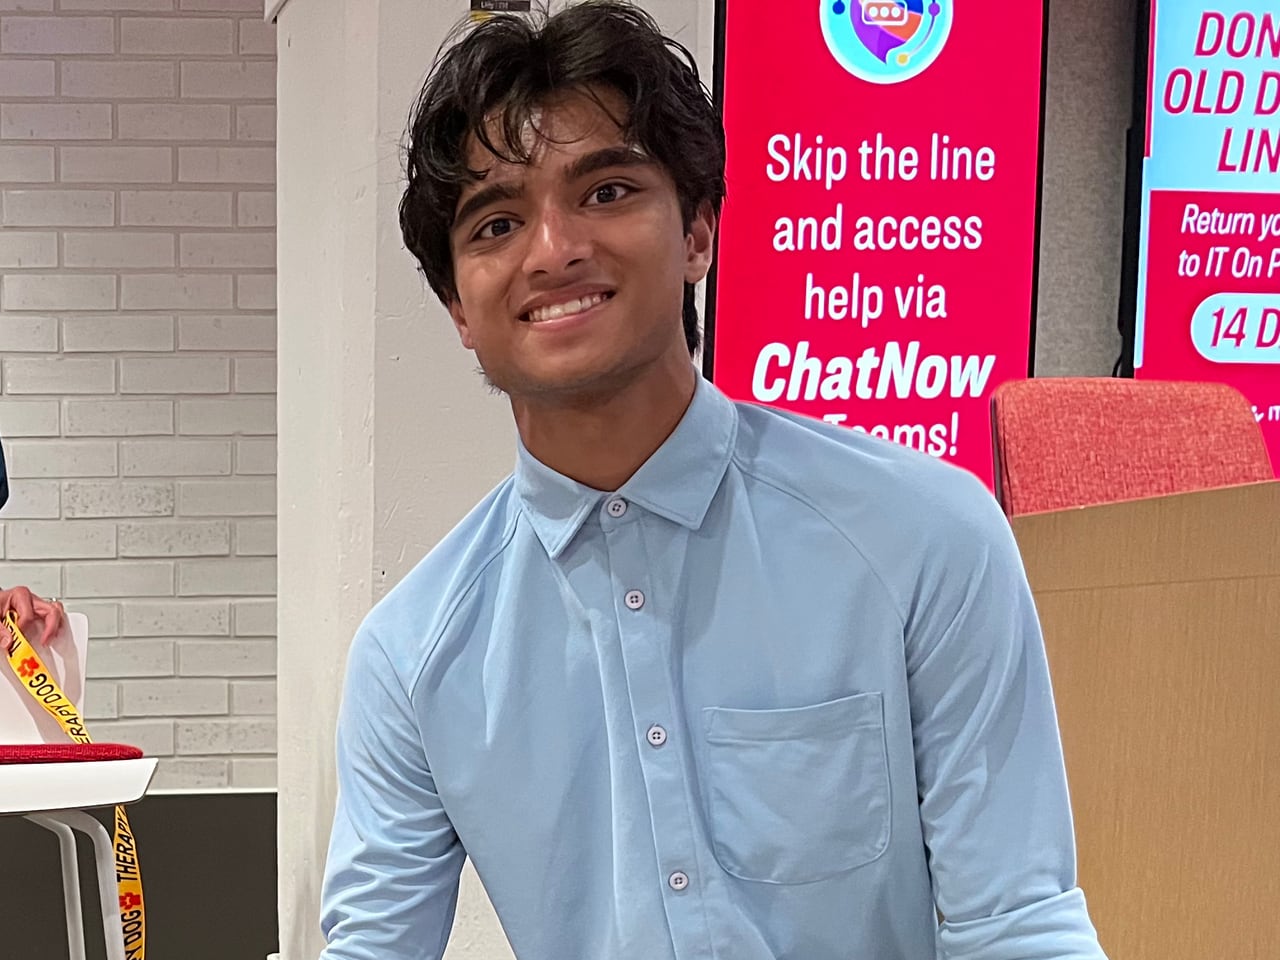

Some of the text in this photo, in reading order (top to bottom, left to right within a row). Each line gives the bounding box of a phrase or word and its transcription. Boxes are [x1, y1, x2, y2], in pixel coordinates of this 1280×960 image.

[1163, 67, 1246, 115] OLD
[766, 133, 995, 190] Skip the line
[772, 203, 982, 251] and access
[1181, 203, 1255, 235] Return
[1178, 249, 1200, 277] to
[1205, 246, 1230, 277] IT
[1231, 246, 1262, 278] On
[804, 272, 947, 328] help via
[1211, 306, 1280, 348] 14 D
[751, 341, 996, 401] ChatNow
[29, 673, 62, 704] DOG
[116, 811, 138, 883] THERAPY
[121, 909, 141, 948] DOG
